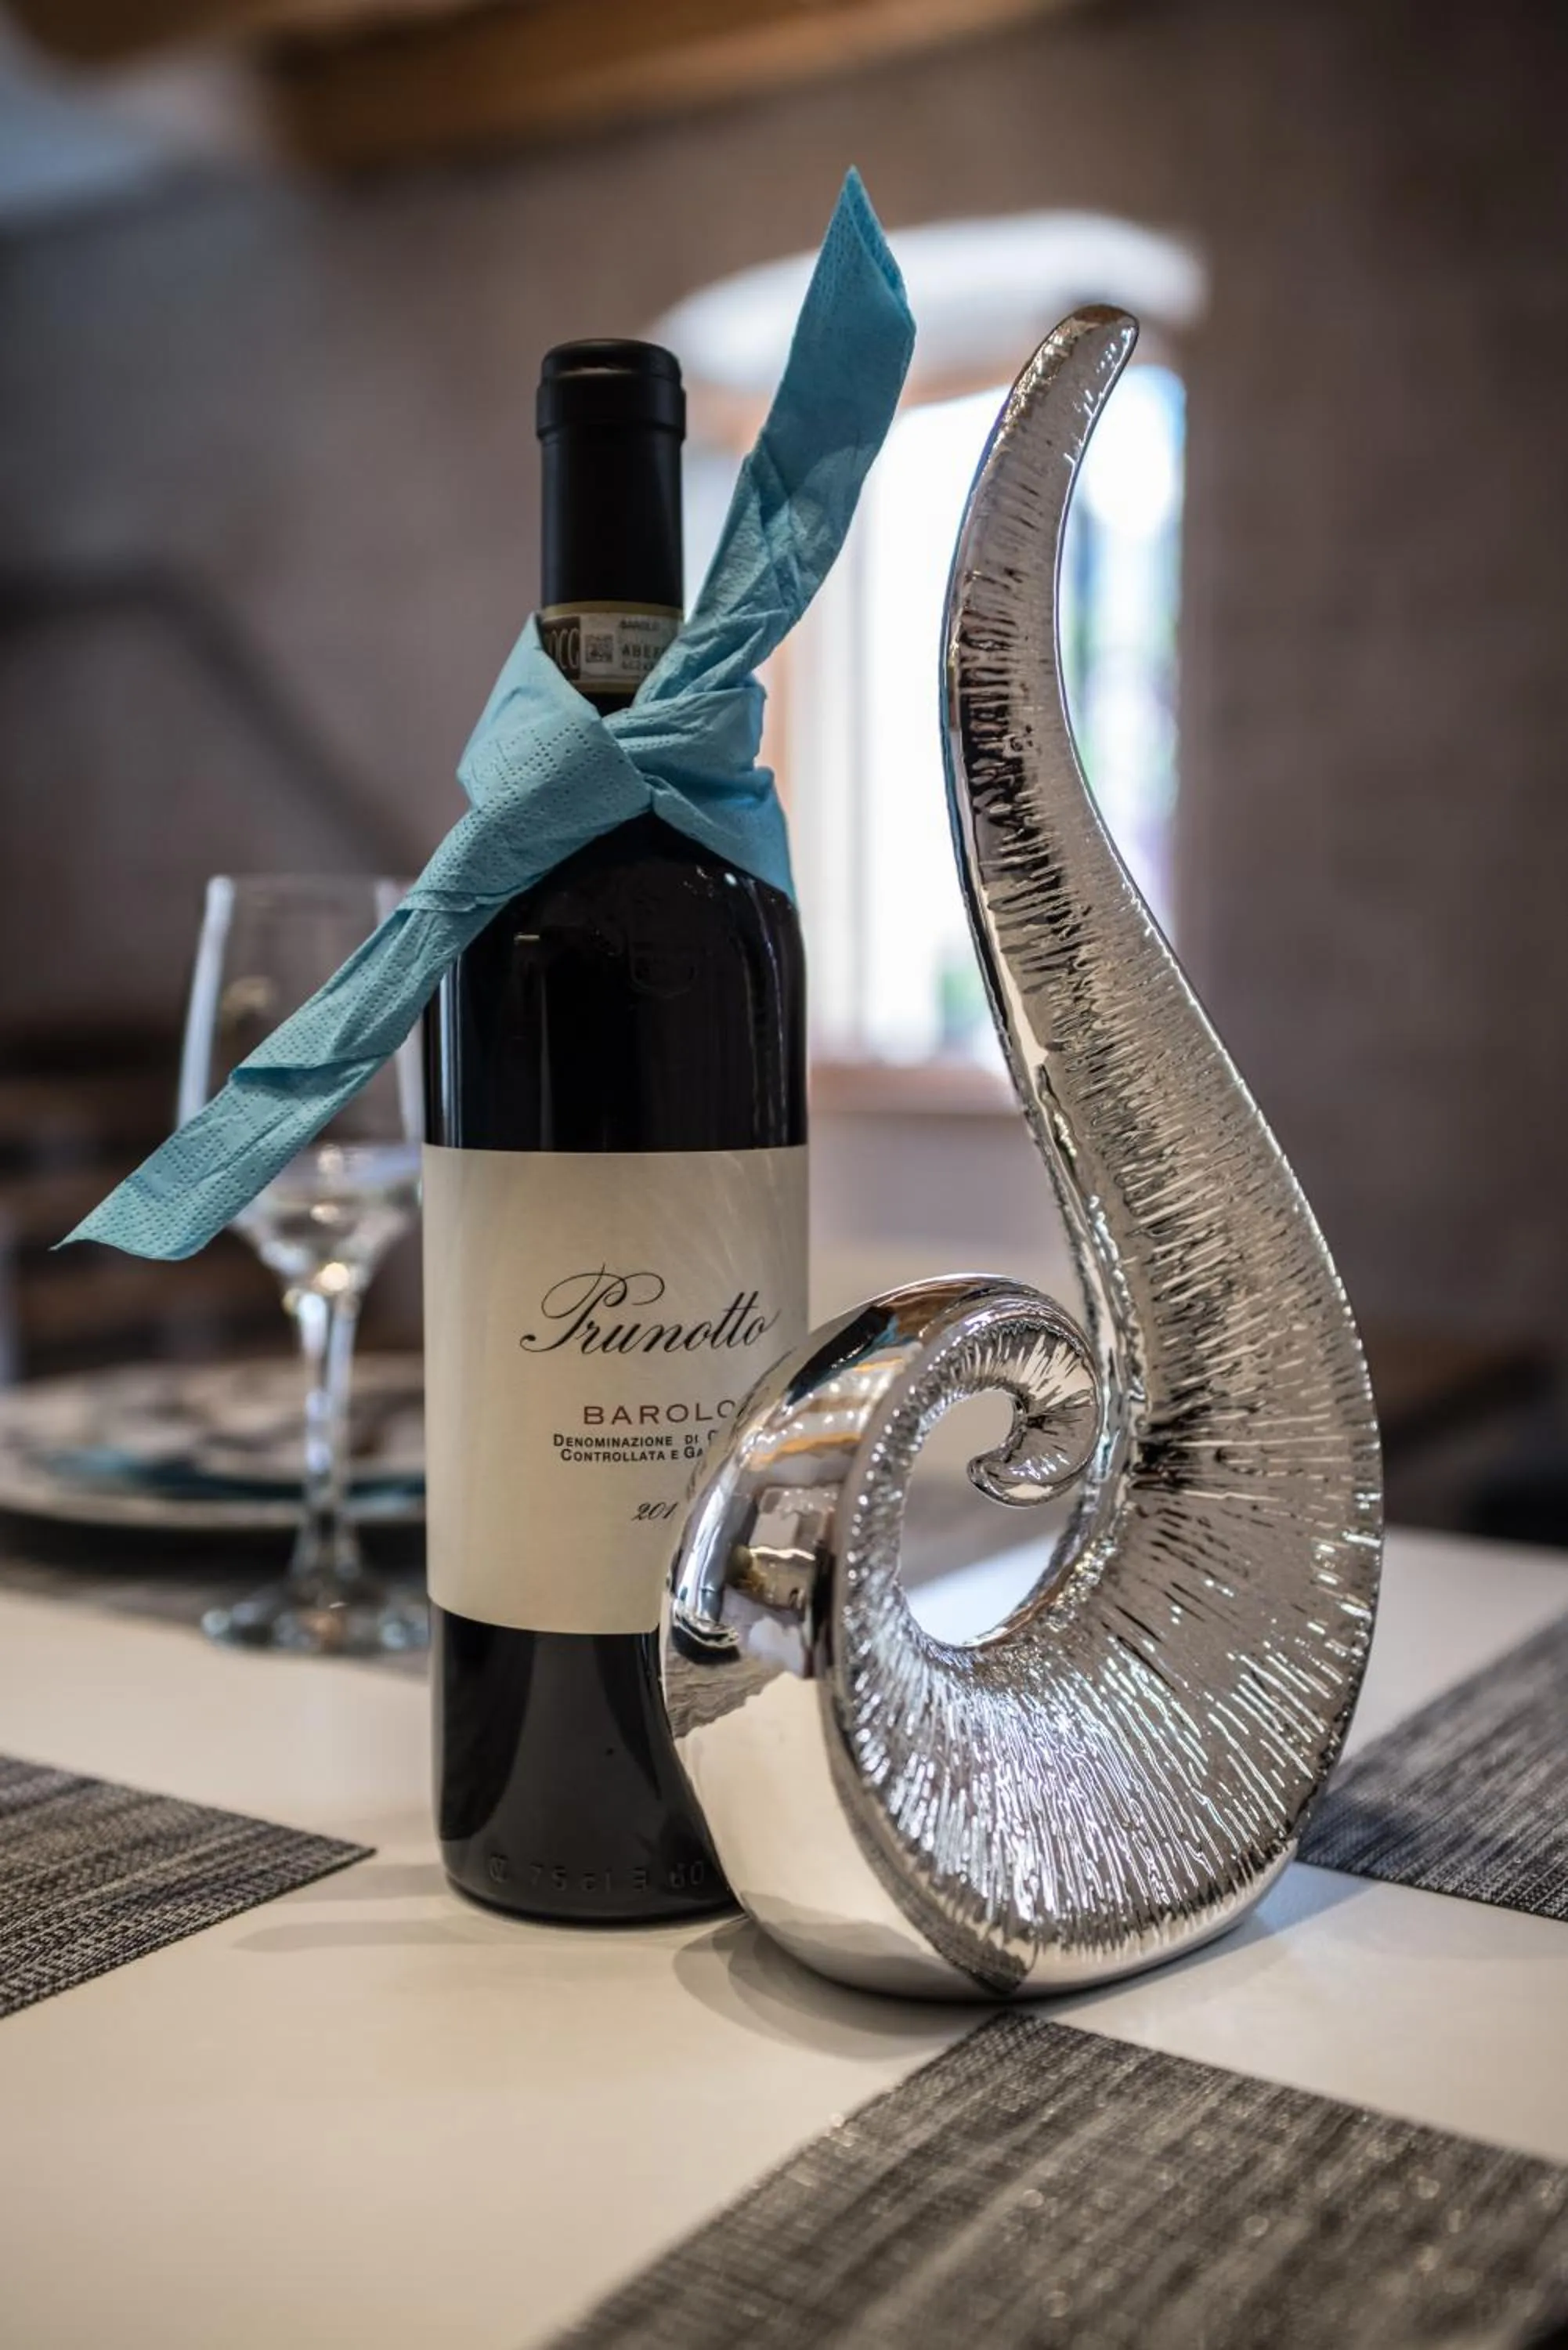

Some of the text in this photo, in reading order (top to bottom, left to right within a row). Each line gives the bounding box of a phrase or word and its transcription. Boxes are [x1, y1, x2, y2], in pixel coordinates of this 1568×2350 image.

[519, 1262, 782, 1355] Prunotto
[553, 1434, 673, 1448] DENOMINAZIONE
[685, 1435, 699, 1445] DI
[560, 1448, 665, 1462] CONTROLLATA
[671, 1451, 679, 1461] E
[631, 1502, 680, 1521] 201
